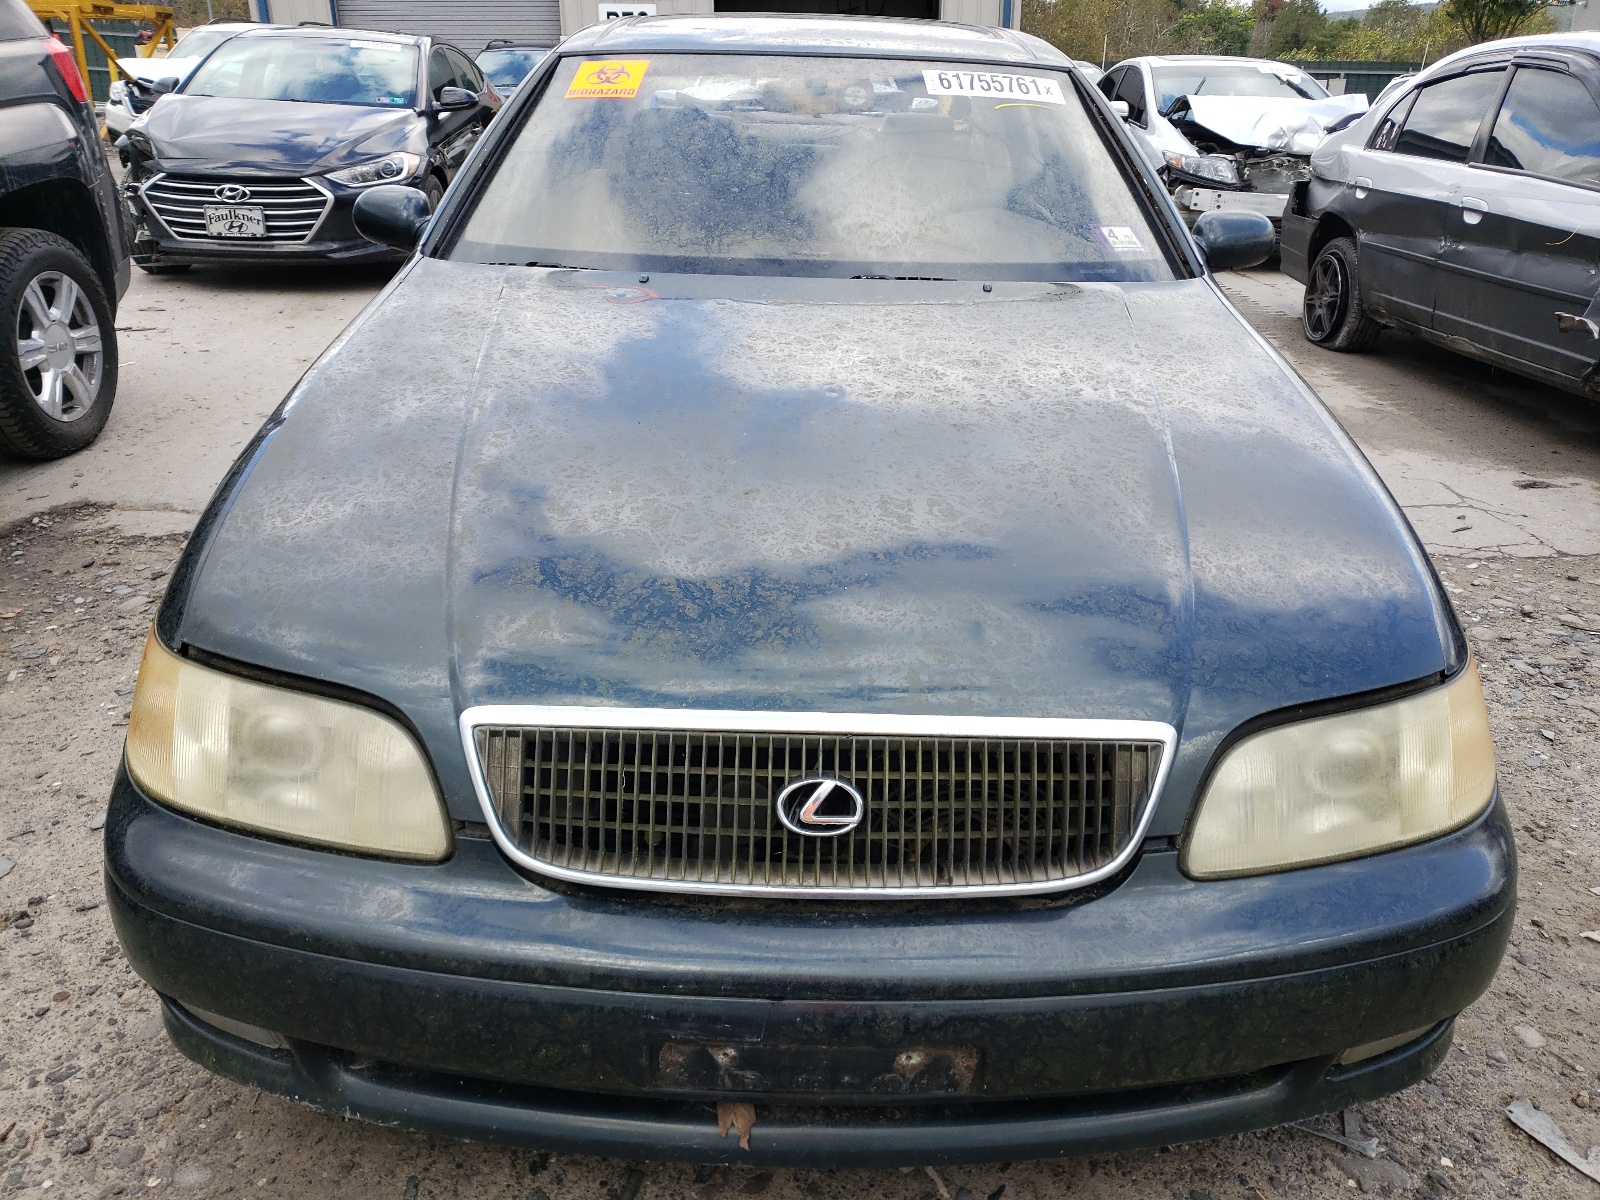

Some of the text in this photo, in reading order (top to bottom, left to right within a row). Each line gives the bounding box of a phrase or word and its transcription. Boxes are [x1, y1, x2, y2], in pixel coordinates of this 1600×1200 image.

[568, 88, 636, 96] BIOHAZARD
[938, 72, 1041, 96] 61755761
[207, 209, 261, 226] Faulkner
